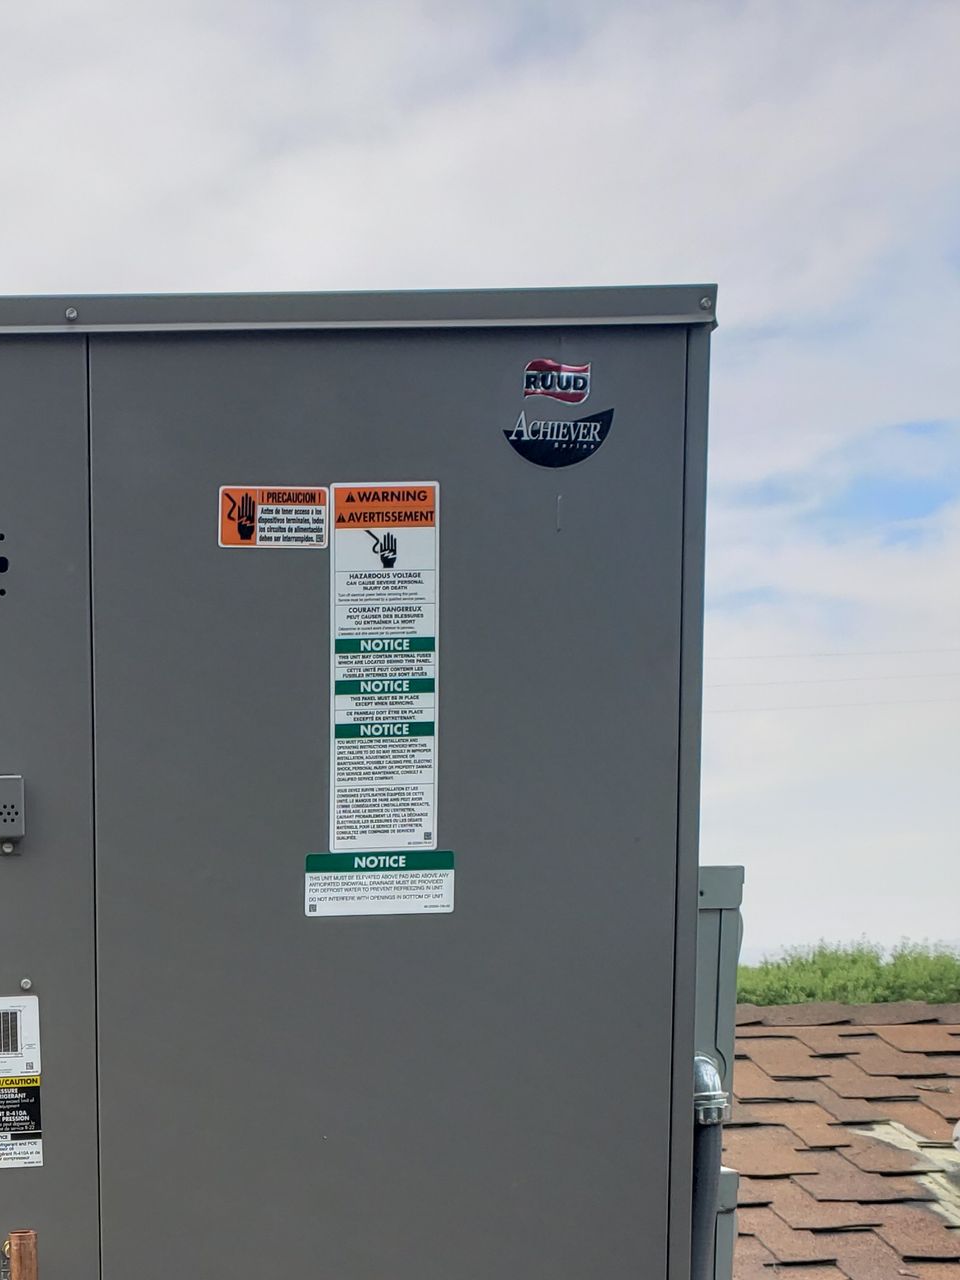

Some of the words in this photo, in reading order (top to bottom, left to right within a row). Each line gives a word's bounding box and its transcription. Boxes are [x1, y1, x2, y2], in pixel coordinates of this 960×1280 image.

[525, 373, 588, 391] RUUD
[267, 492, 316, 503] PRECAUCION
[358, 490, 428, 502] WARNING
[347, 511, 435, 522] AVERTISSEMENT
[360, 639, 410, 651] NOTICE
[360, 680, 409, 692] NOTICE
[360, 724, 409, 735] NOTICE
[354, 856, 406, 868] NOTICE
